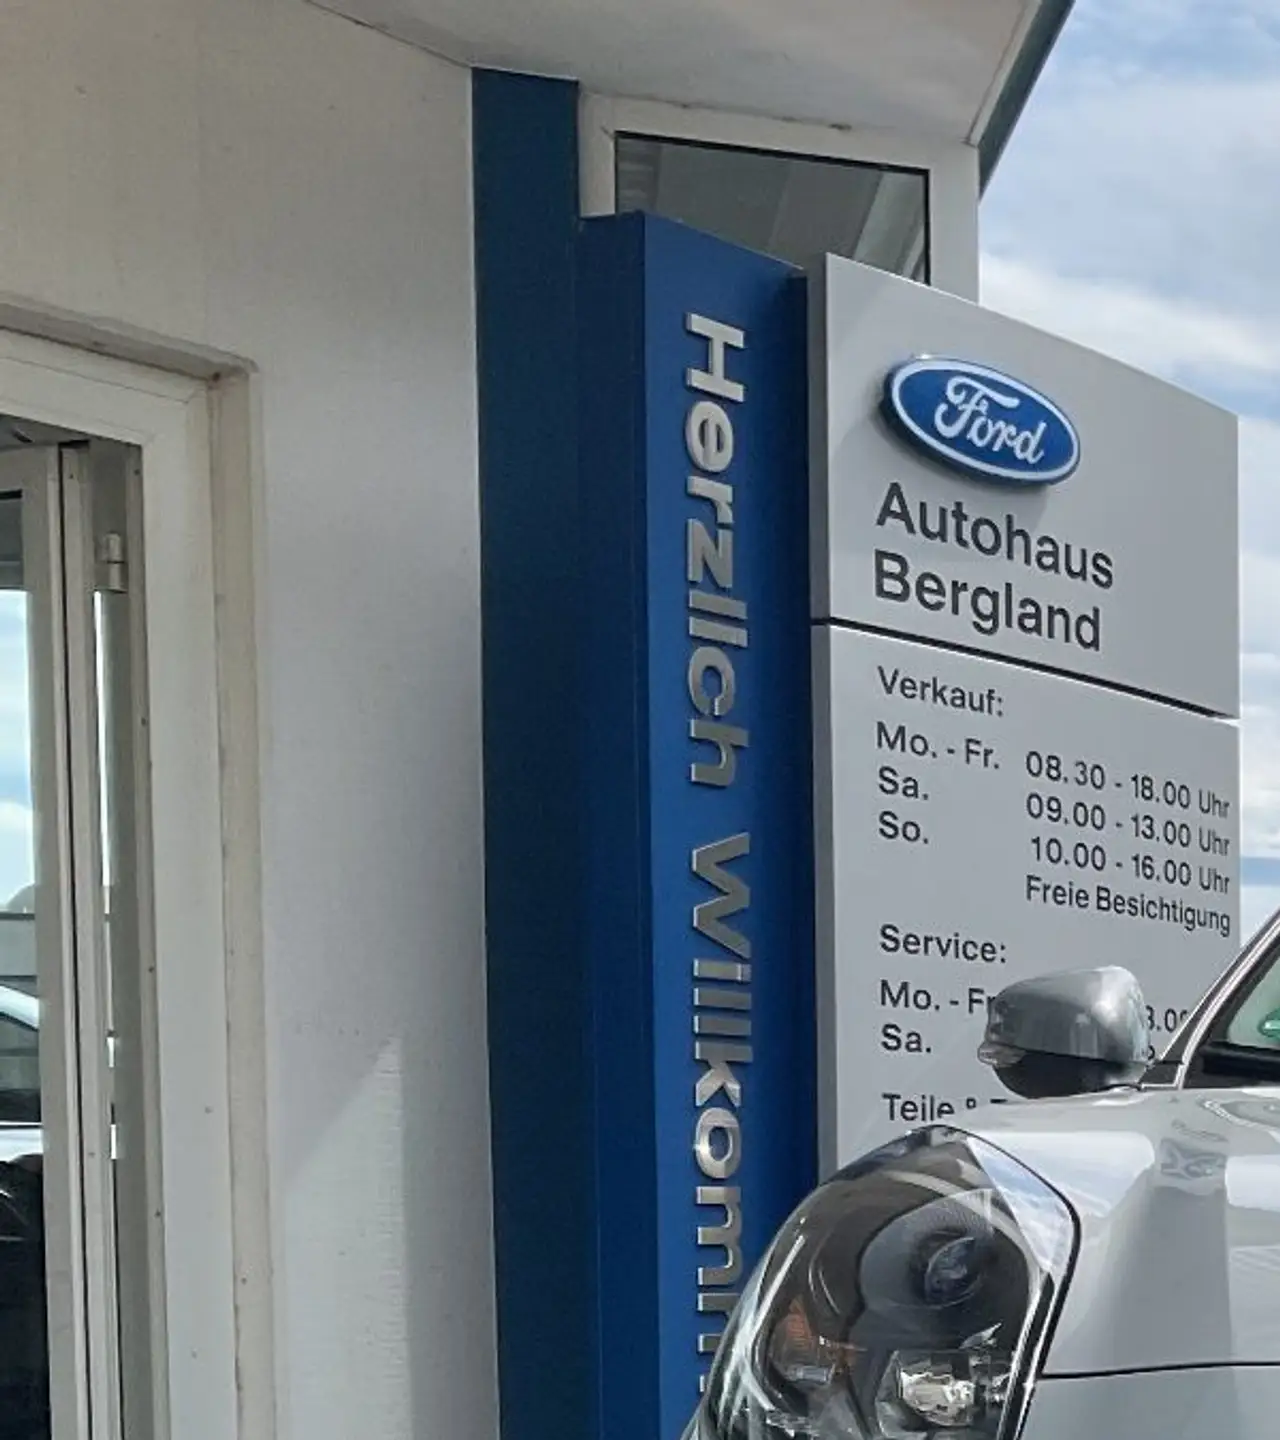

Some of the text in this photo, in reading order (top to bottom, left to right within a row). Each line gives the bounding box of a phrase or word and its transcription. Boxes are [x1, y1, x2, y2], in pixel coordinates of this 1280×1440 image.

[934, 375, 1046, 464] Ford
[685, 312, 749, 786] Herzlich
[876, 481, 1114, 589] Autohaus
[874, 549, 1101, 651] Bergland
[877, 665, 1003, 717] Verkauf:
[877, 721, 937, 758] Mo.
[965, 738, 1000, 769] Fr.
[1026, 751, 1105, 790] 08.30
[1131, 774, 1191, 809] 18.00
[1199, 789, 1230, 818] Uhr
[879, 766, 929, 800] Sa.
[1026, 793, 1106, 831] 09.00
[1131, 814, 1191, 848] 13.00
[1199, 828, 1230, 856] Uhr
[879, 811, 929, 844] So.
[1031, 836, 1106, 871] 10.00
[1131, 854, 1192, 886] 16.00
[1199, 866, 1230, 894] Uhr
[880, 924, 1006, 963] Service:
[1026, 875, 1230, 938] Freie Besichtigung
[880, 979, 940, 1010] Mo.
[881, 1023, 931, 1053] Sa.
[882, 1093, 955, 1121] Teile
